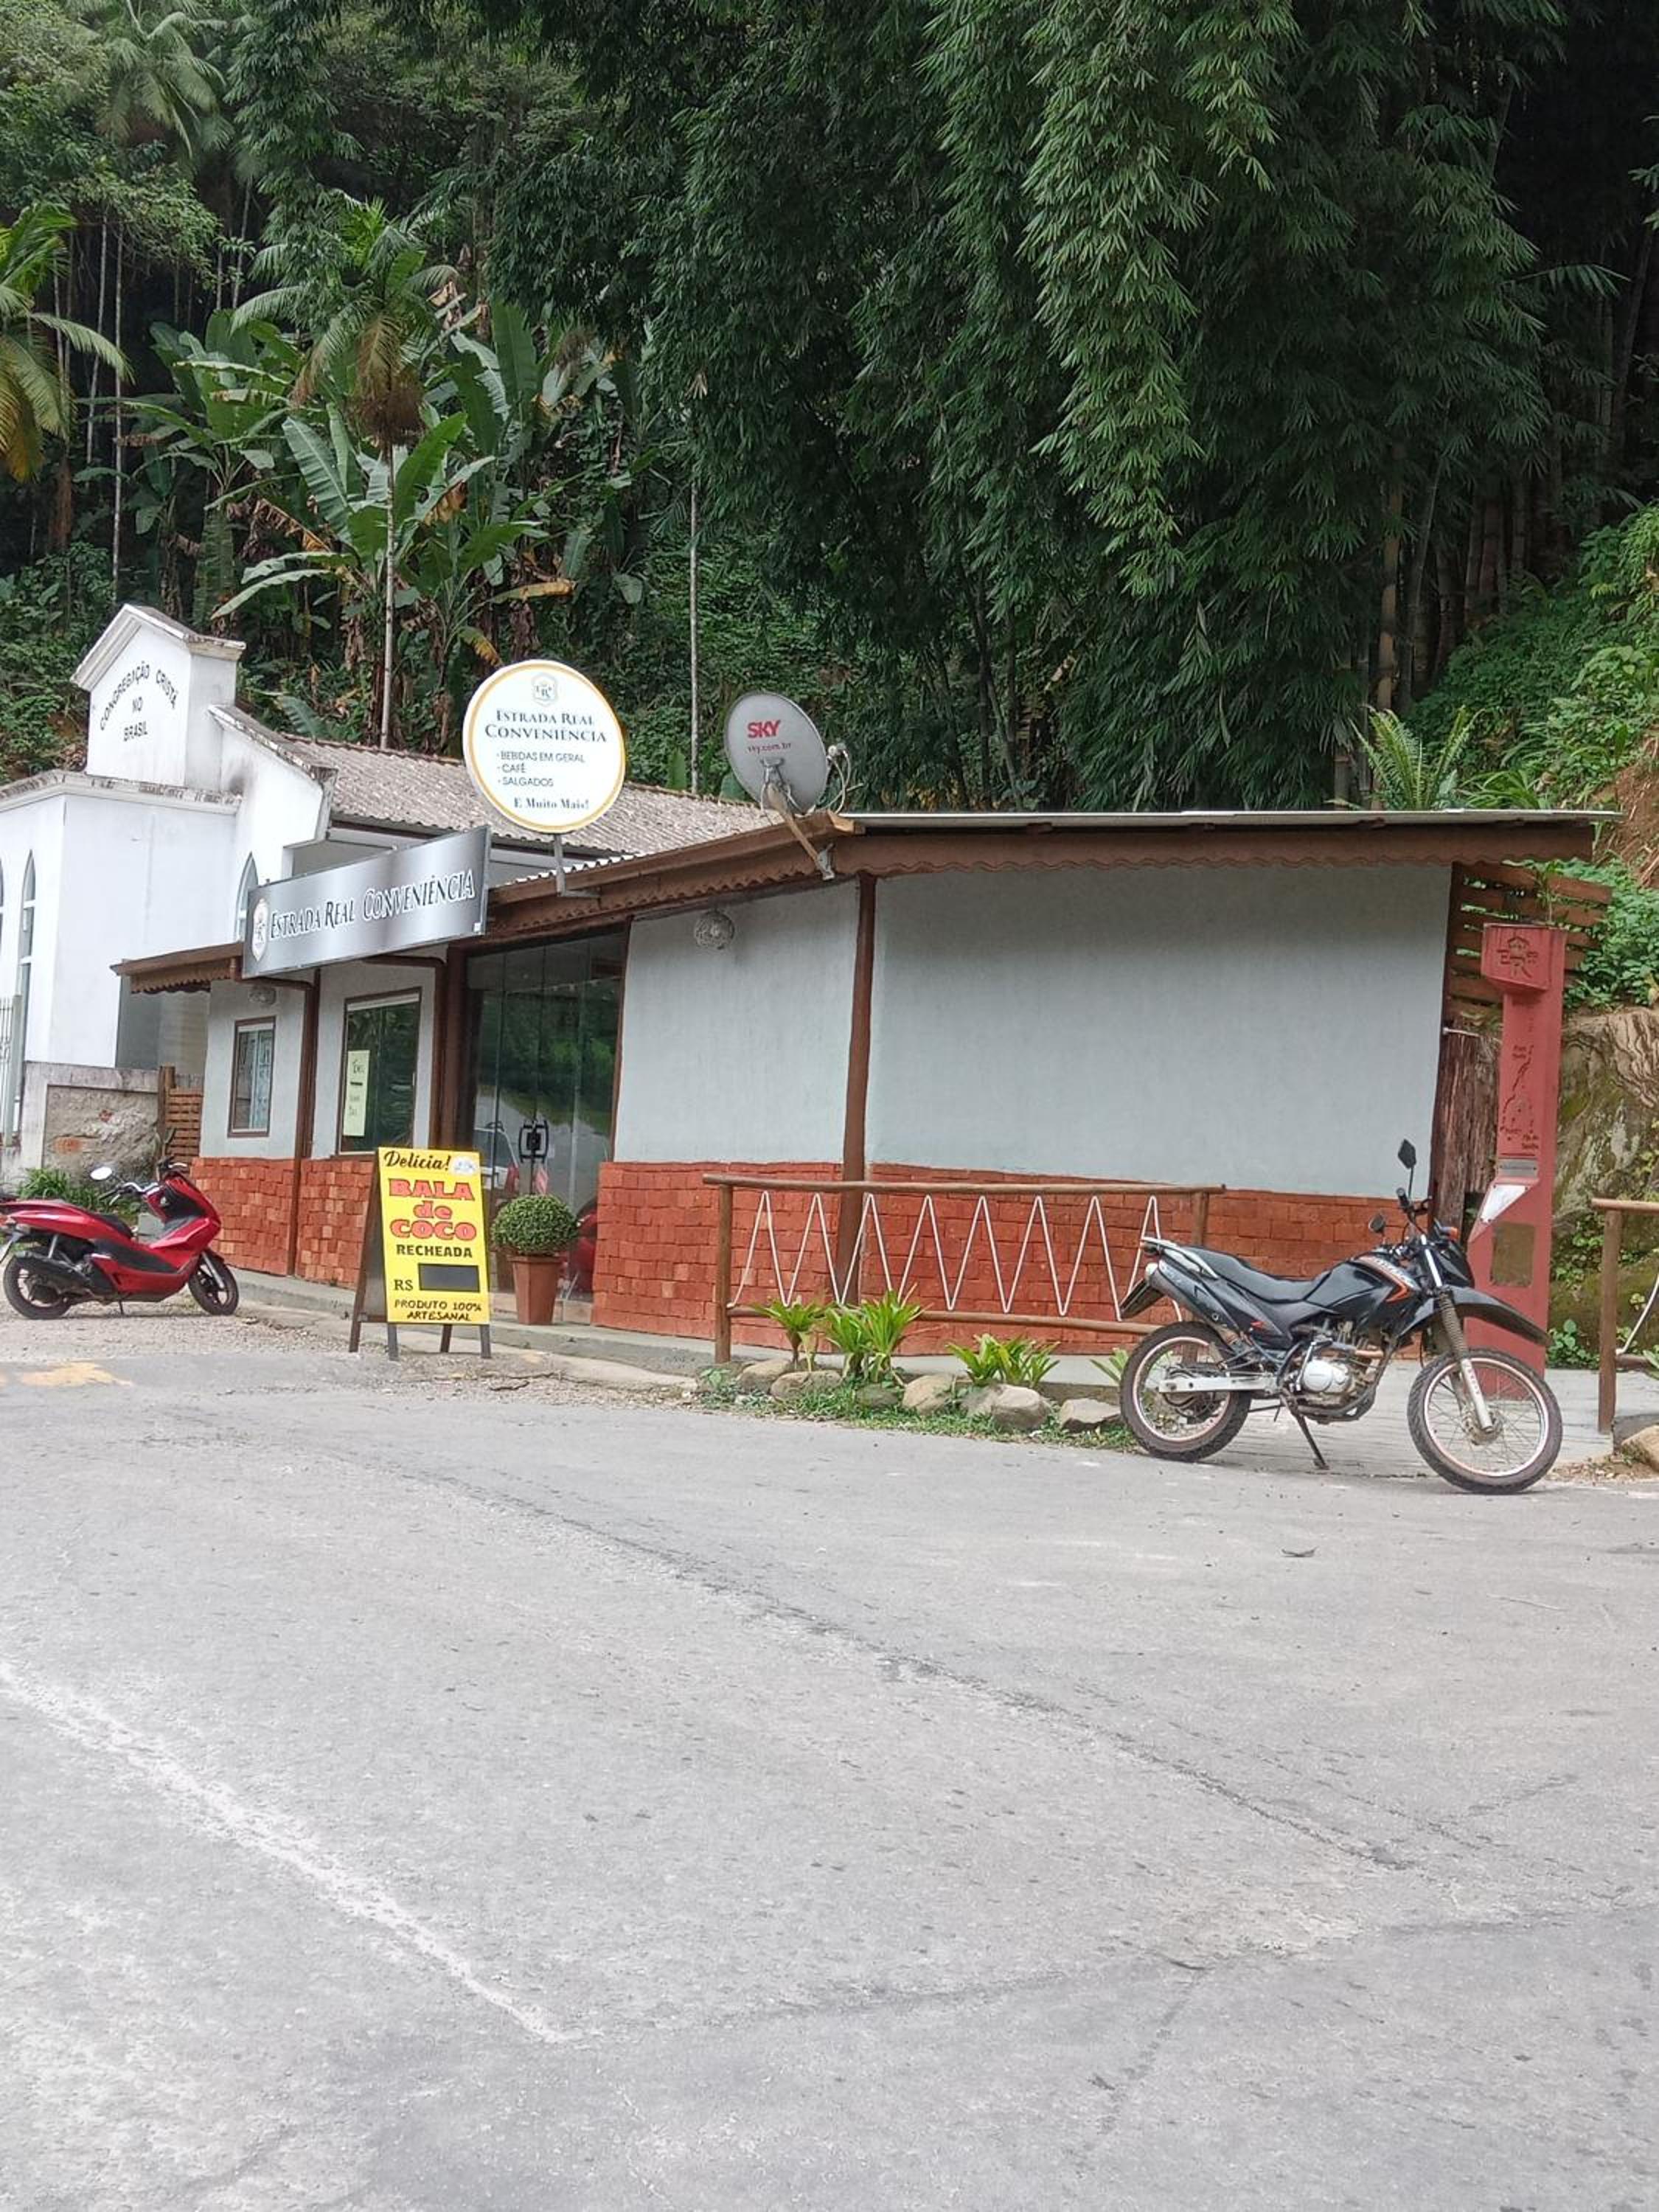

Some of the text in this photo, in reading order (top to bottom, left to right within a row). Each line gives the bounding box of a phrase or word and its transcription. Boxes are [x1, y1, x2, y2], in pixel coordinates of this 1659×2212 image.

[133, 697, 144, 713] NO
[495, 709, 594, 726] ESTRADA REAL
[124, 721, 147, 741] BRASIL
[747, 720, 781, 738] SKY
[540, 751, 554, 762] EM
[556, 753, 585, 763] GERAL
[503, 776, 554, 787] SALGADOS
[514, 797, 589, 810] E Muito Mais!
[271, 907, 321, 939] ESTRADA
[324, 900, 355, 930] REAL
[363, 869, 476, 922] CONVENIÊNCIA
[389, 1178, 476, 1201] BALA
[412, 1200, 453, 1220] de
[389, 1219, 477, 1241] COCO
[396, 1244, 473, 1258] RECHEADA
[394, 1299, 481, 1312] PRODUTO 100%
[407, 1310, 472, 1321] ARTESANAL
